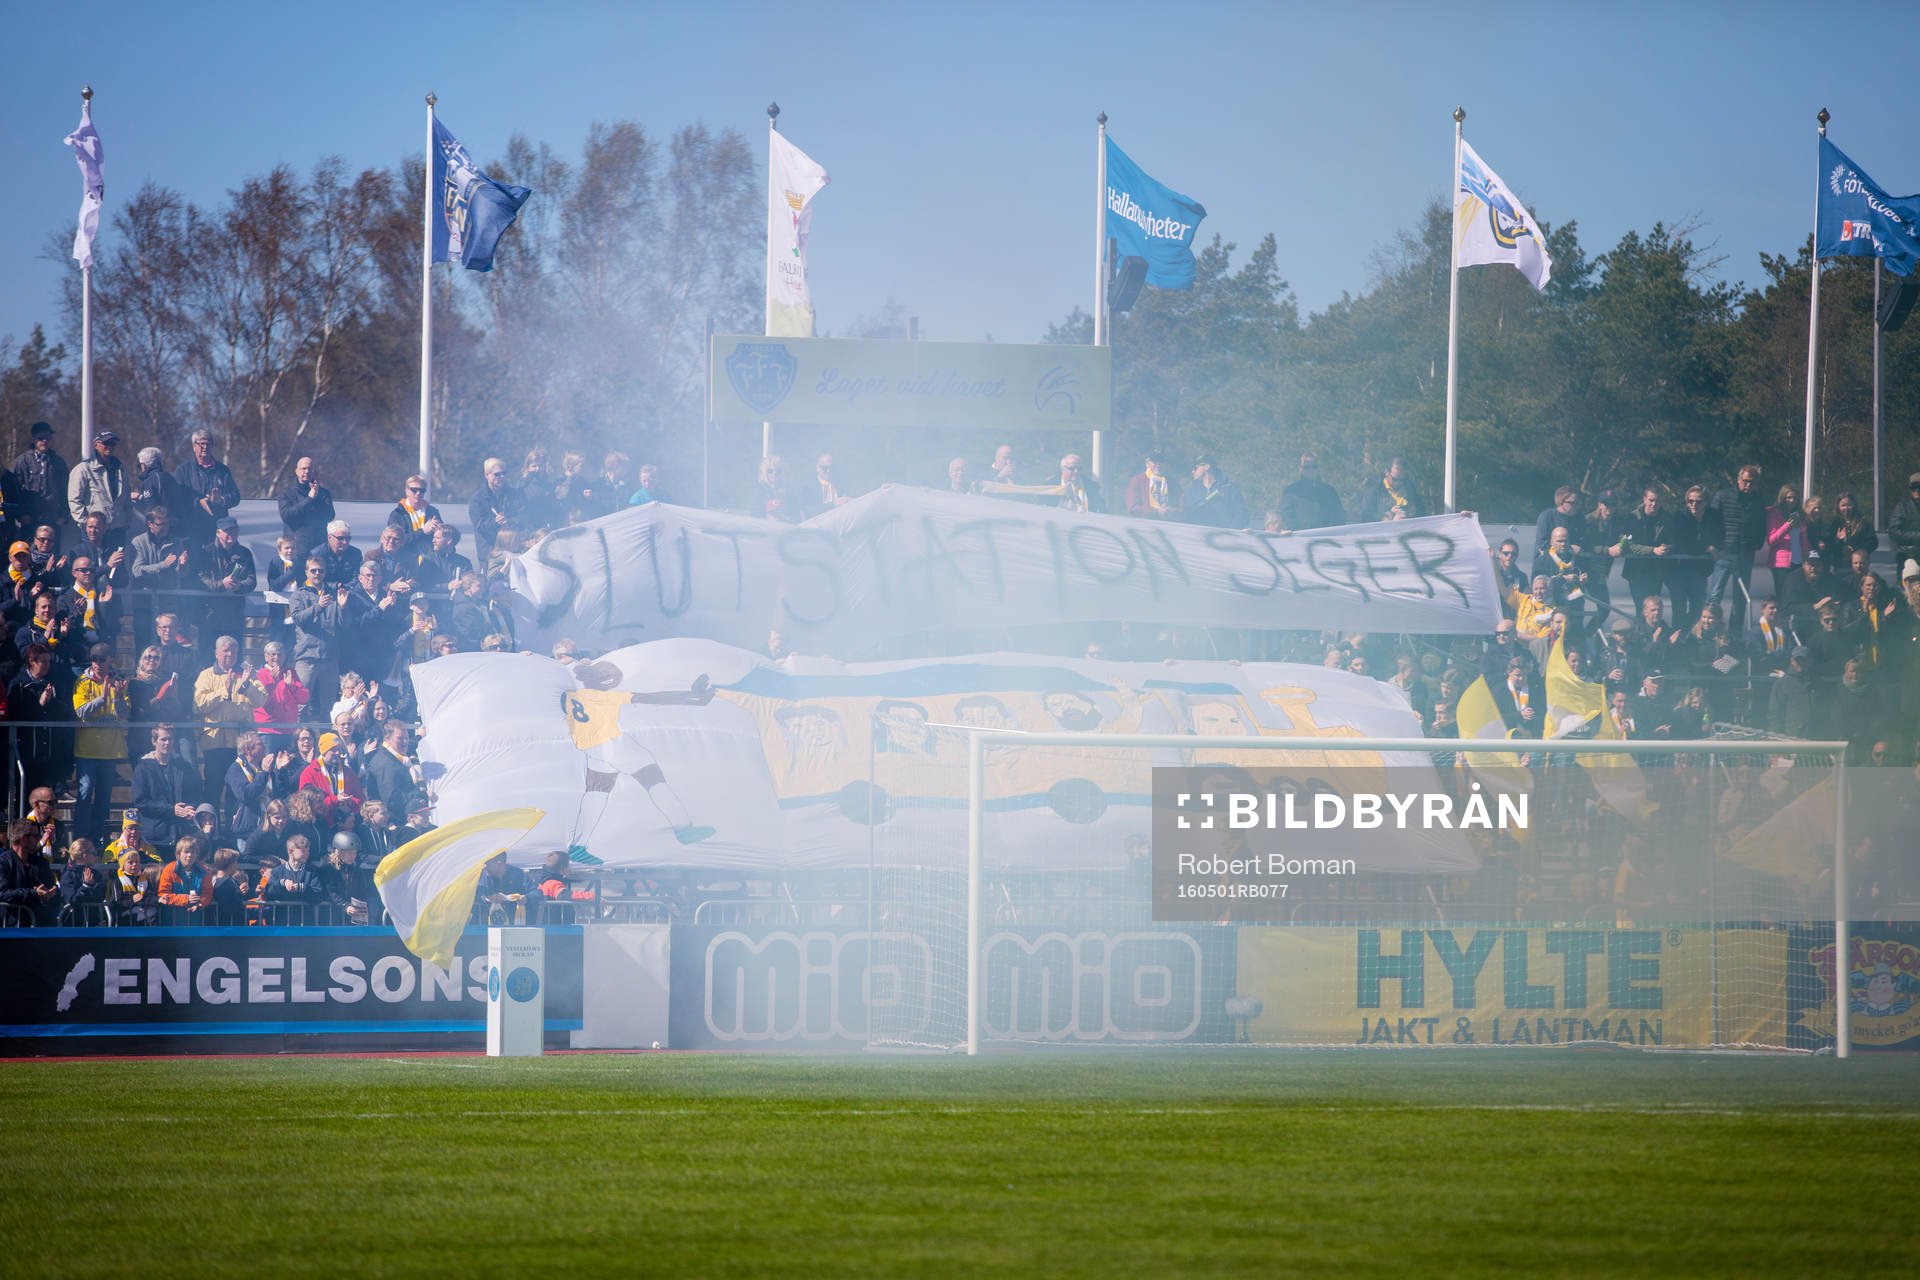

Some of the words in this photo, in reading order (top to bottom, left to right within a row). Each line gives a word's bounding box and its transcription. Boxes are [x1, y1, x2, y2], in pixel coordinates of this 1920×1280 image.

[1204, 529, 1471, 608] SEGER
[1357, 929, 1663, 1009] HYLTE
[1356, 1017, 1440, 1045] JAKT
[1454, 1016, 1474, 1044] &
[1493, 1017, 1663, 1046] LANTMAN
